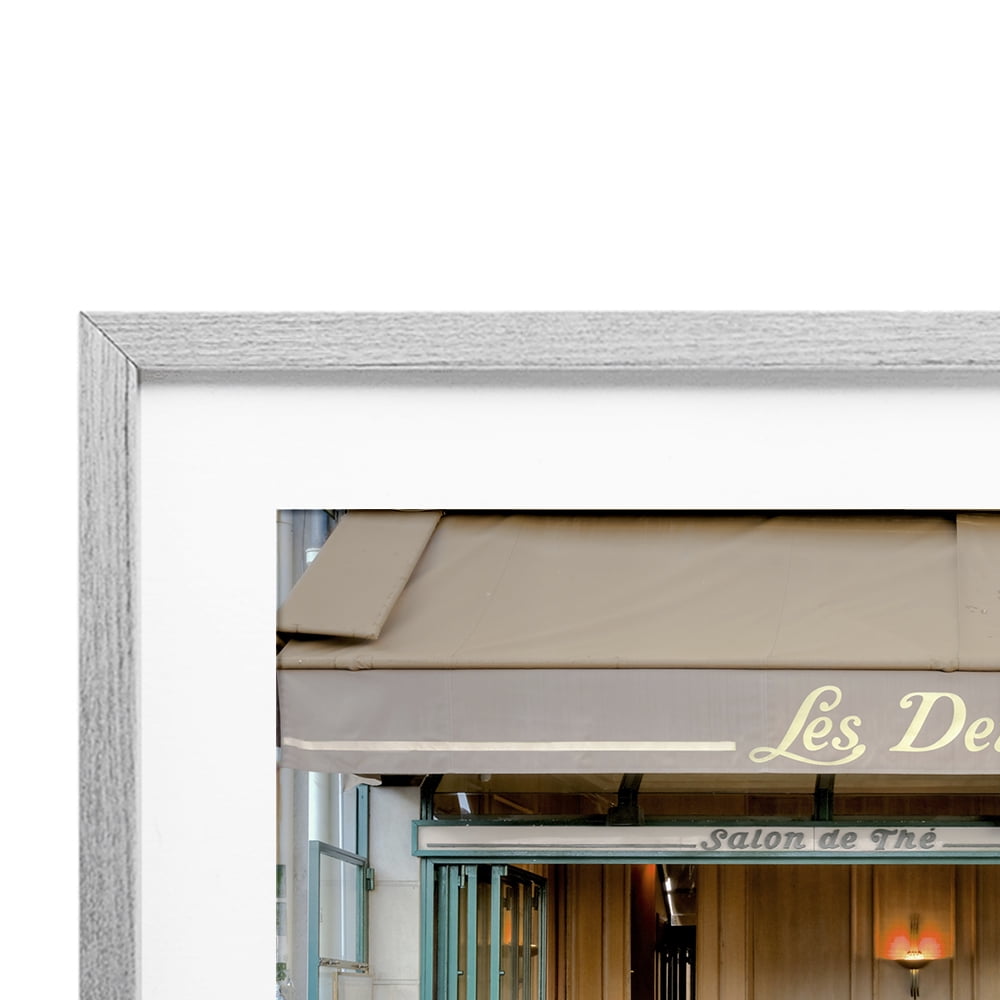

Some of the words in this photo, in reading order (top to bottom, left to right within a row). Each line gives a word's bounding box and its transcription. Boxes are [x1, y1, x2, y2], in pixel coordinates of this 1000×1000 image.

[749, 685, 866, 766] Les
[701, 828, 806, 850] Salon
[818, 829, 857, 849] de
[871, 828, 936, 850] Thé
